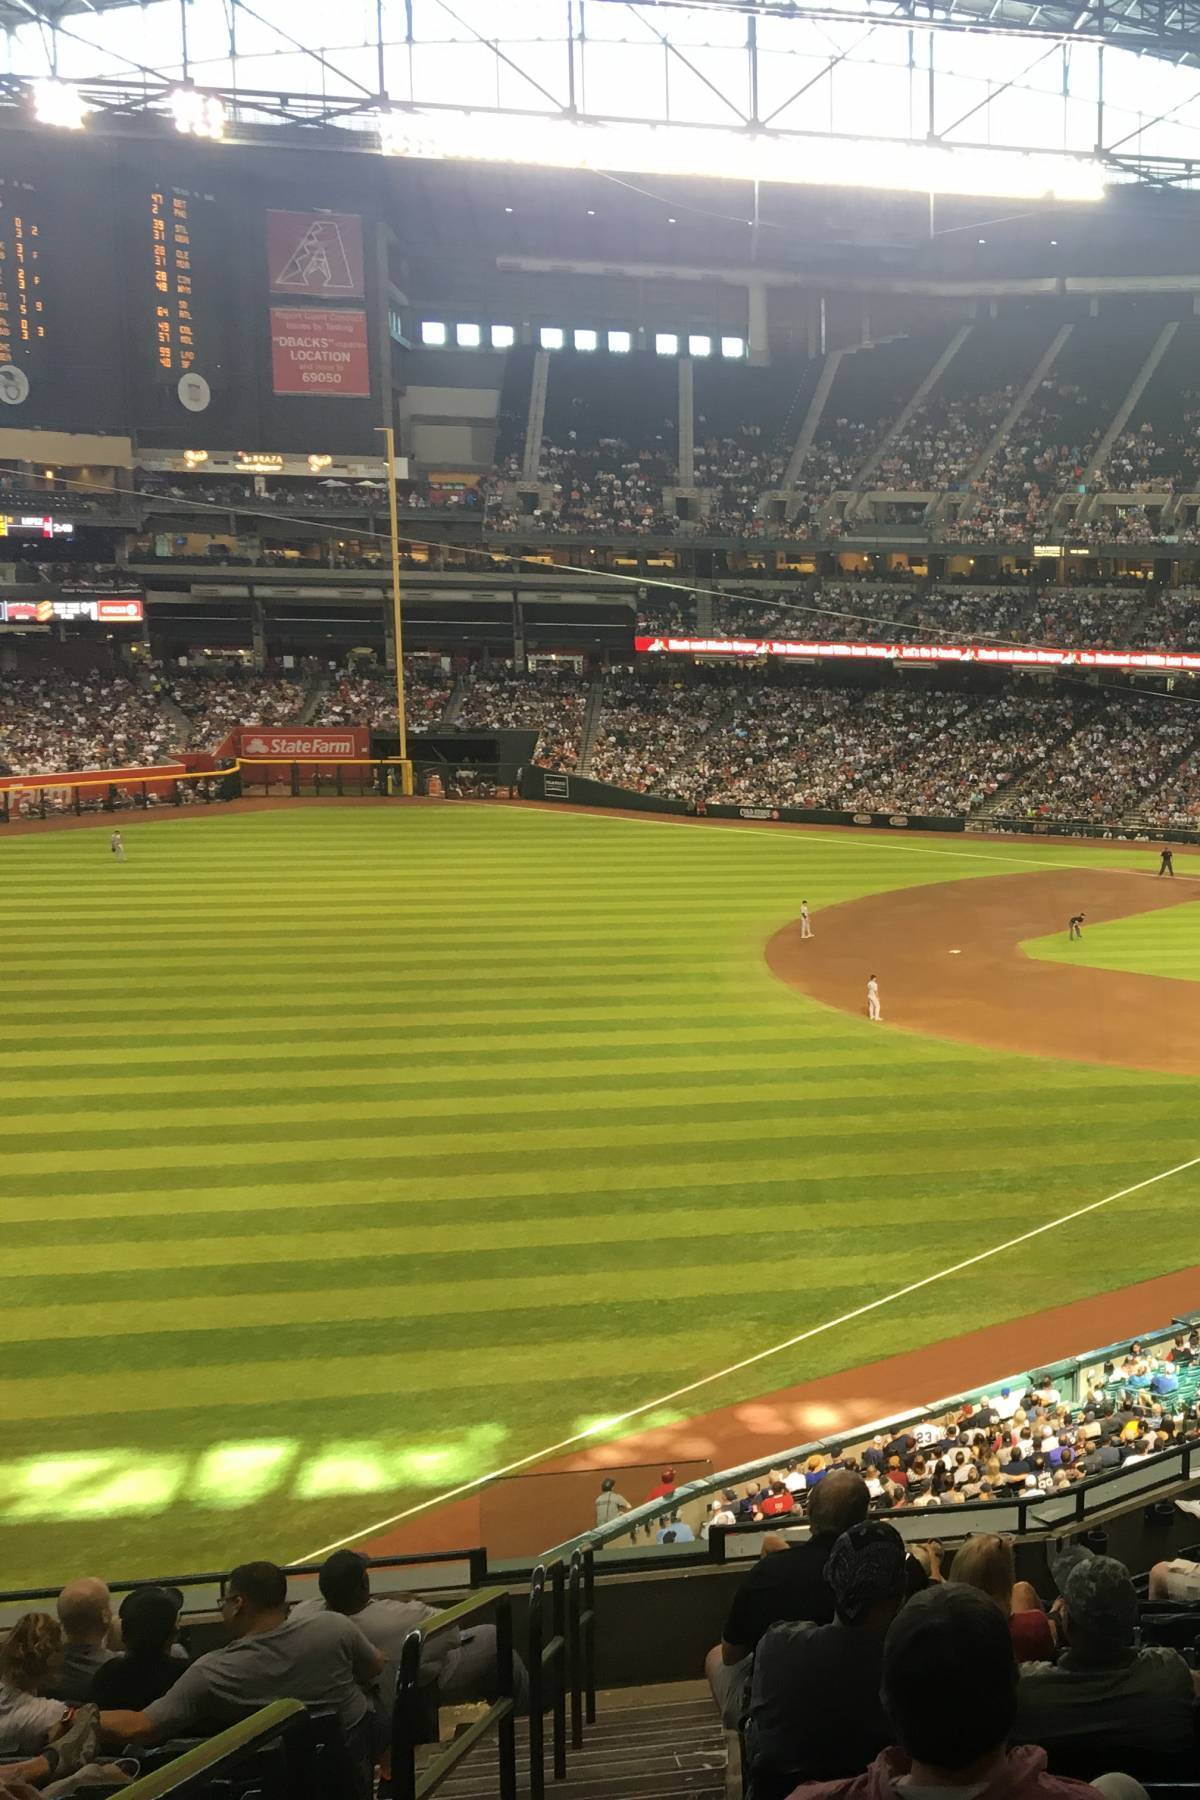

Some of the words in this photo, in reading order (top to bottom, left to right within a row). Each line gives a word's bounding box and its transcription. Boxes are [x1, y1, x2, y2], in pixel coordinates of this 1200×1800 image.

[290, 350, 350, 362] LOCATION
[302, 372, 342, 384] 69050
[916, 1432, 932, 1444] 23
